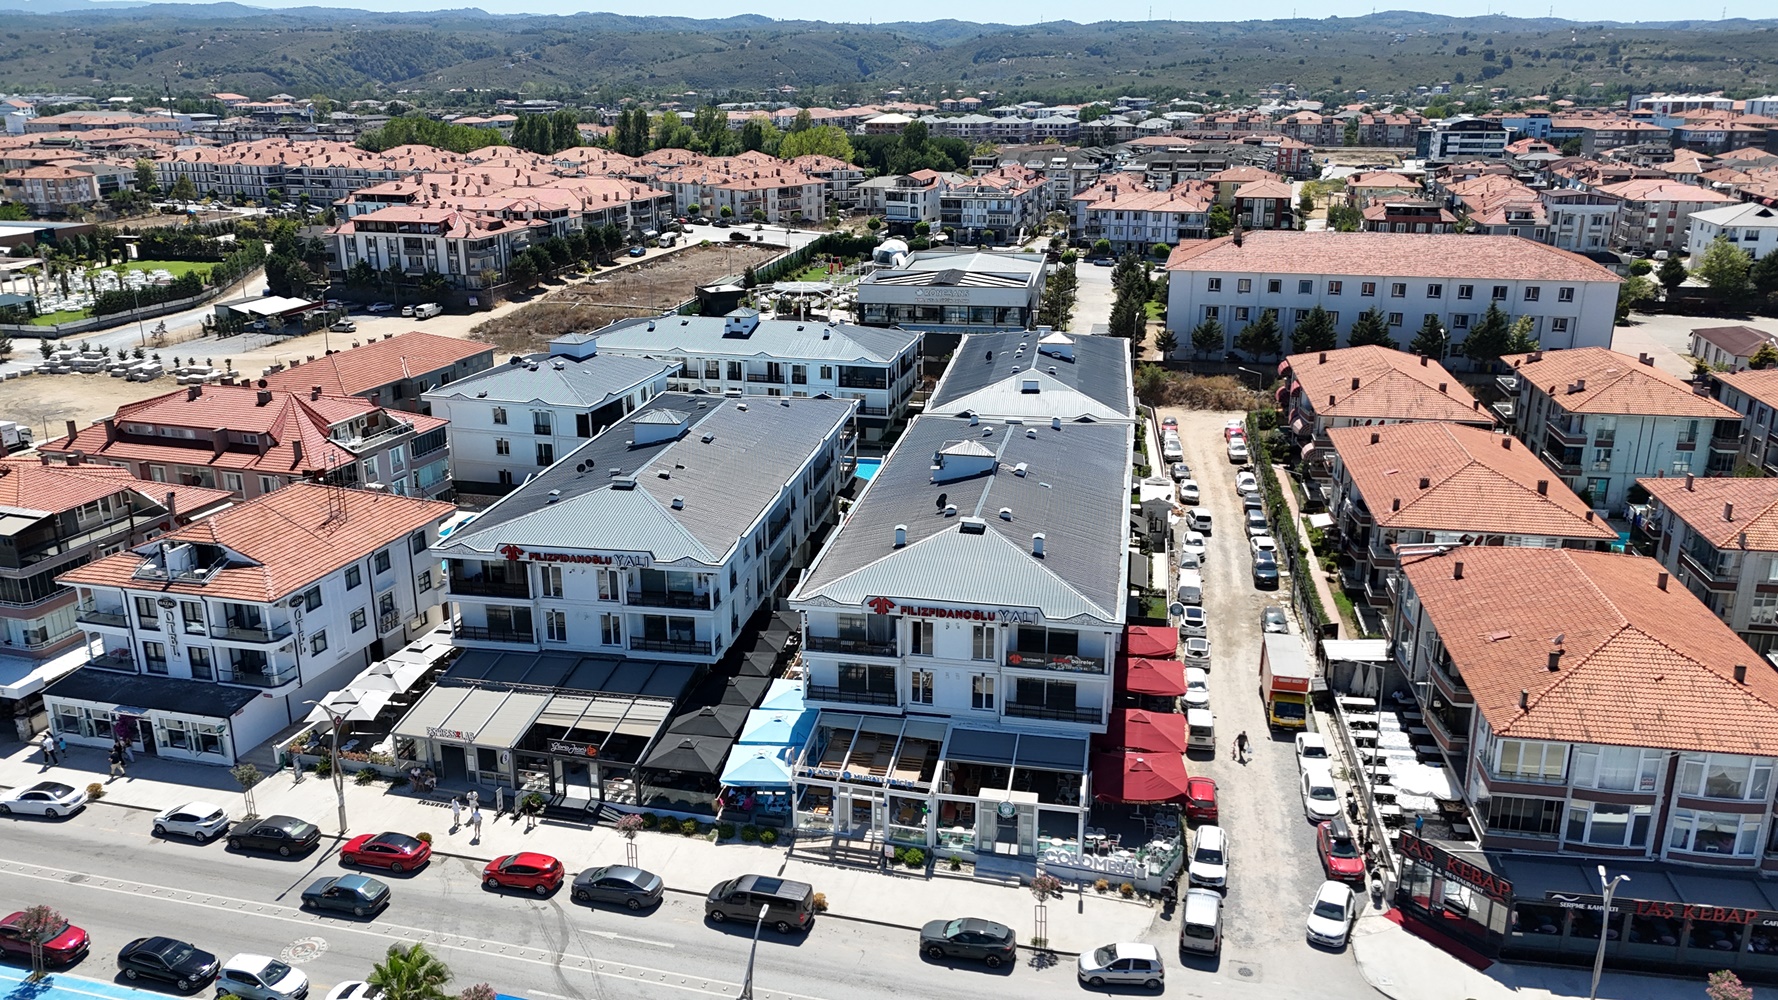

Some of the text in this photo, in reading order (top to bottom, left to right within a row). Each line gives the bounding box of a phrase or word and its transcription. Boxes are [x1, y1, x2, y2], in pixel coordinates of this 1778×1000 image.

[613, 554, 650, 568] YALI
[998, 609, 1039, 626] YALI
[1419, 858, 1435, 870] CAFE
[1444, 870, 1485, 894] RESTAURANT
[1447, 855, 1511, 896] KEBAP
[1560, 901, 1619, 913] SERPME KAHVLTI
[1682, 905, 1758, 925] KEBAP
